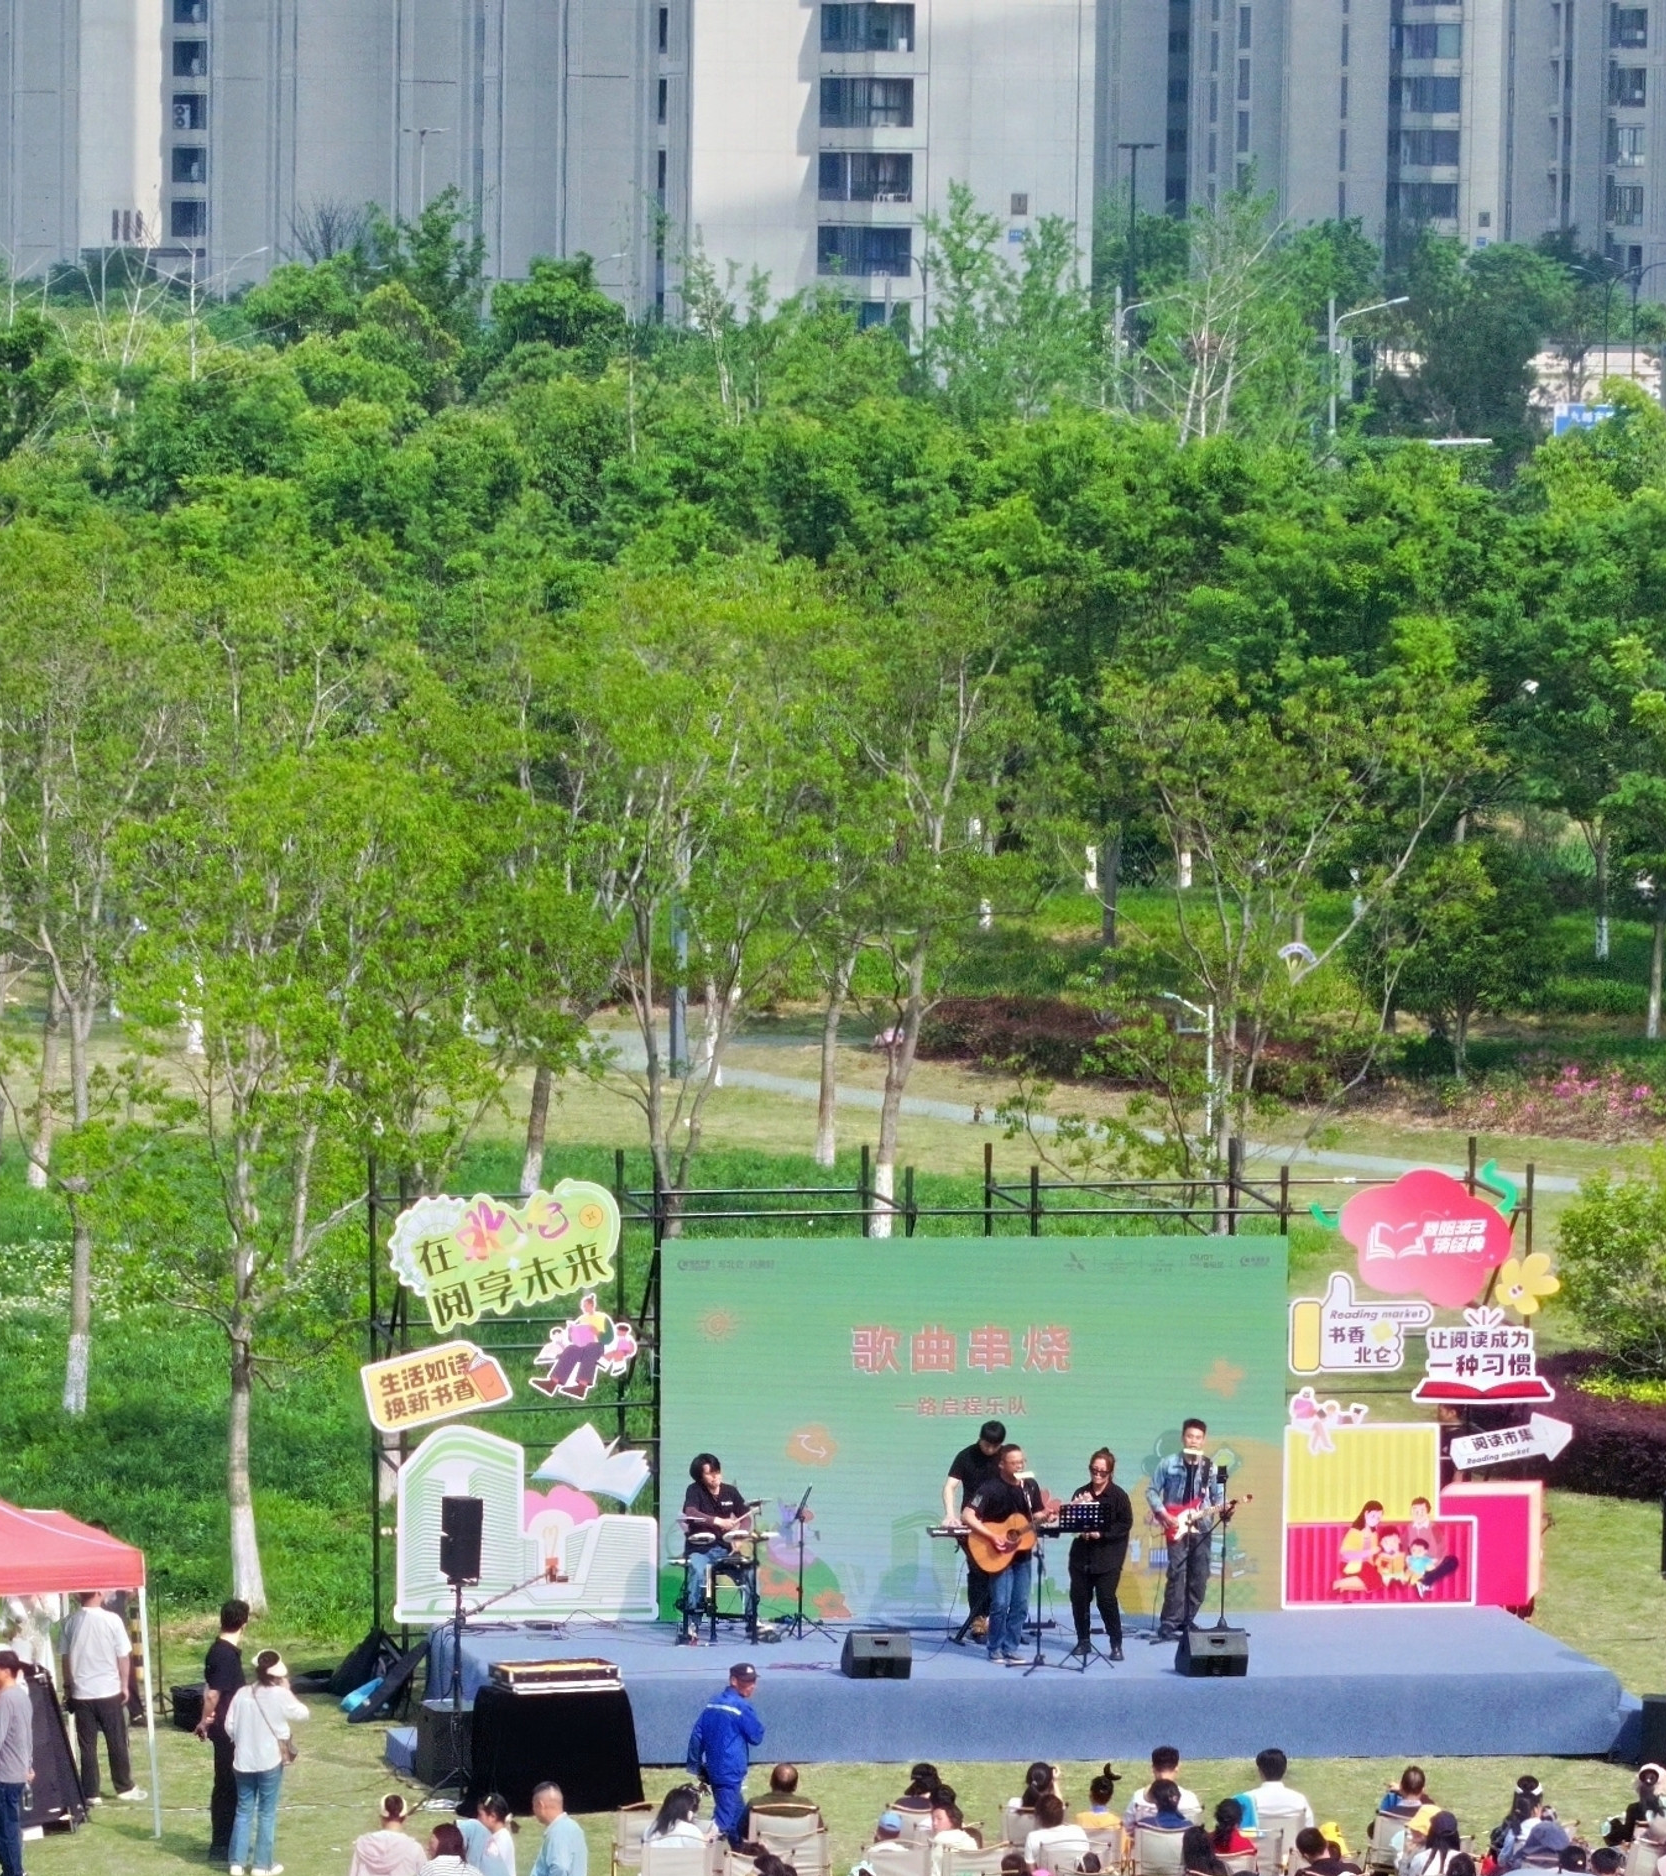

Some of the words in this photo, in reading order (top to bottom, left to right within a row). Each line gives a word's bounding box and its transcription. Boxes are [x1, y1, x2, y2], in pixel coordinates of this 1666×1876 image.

[432, 1243, 608, 1327] 阅享未来
[1330, 1308, 1379, 1321] Reading
[1381, 1309, 1425, 1319] market
[1329, 1326, 1365, 1344] 书香
[1430, 1330, 1530, 1349] 让阅读成为
[851, 1325, 1071, 1375] 歌曲串烧
[1354, 1347, 1392, 1364] 北仑
[1429, 1353, 1531, 1376] 一种习惯
[895, 1396, 1027, 1417] 一路启程乐队
[1471, 1428, 1535, 1451] 阅读市集
[1466, 1454, 1499, 1465] Reading
[1502, 1447, 1530, 1458] market
